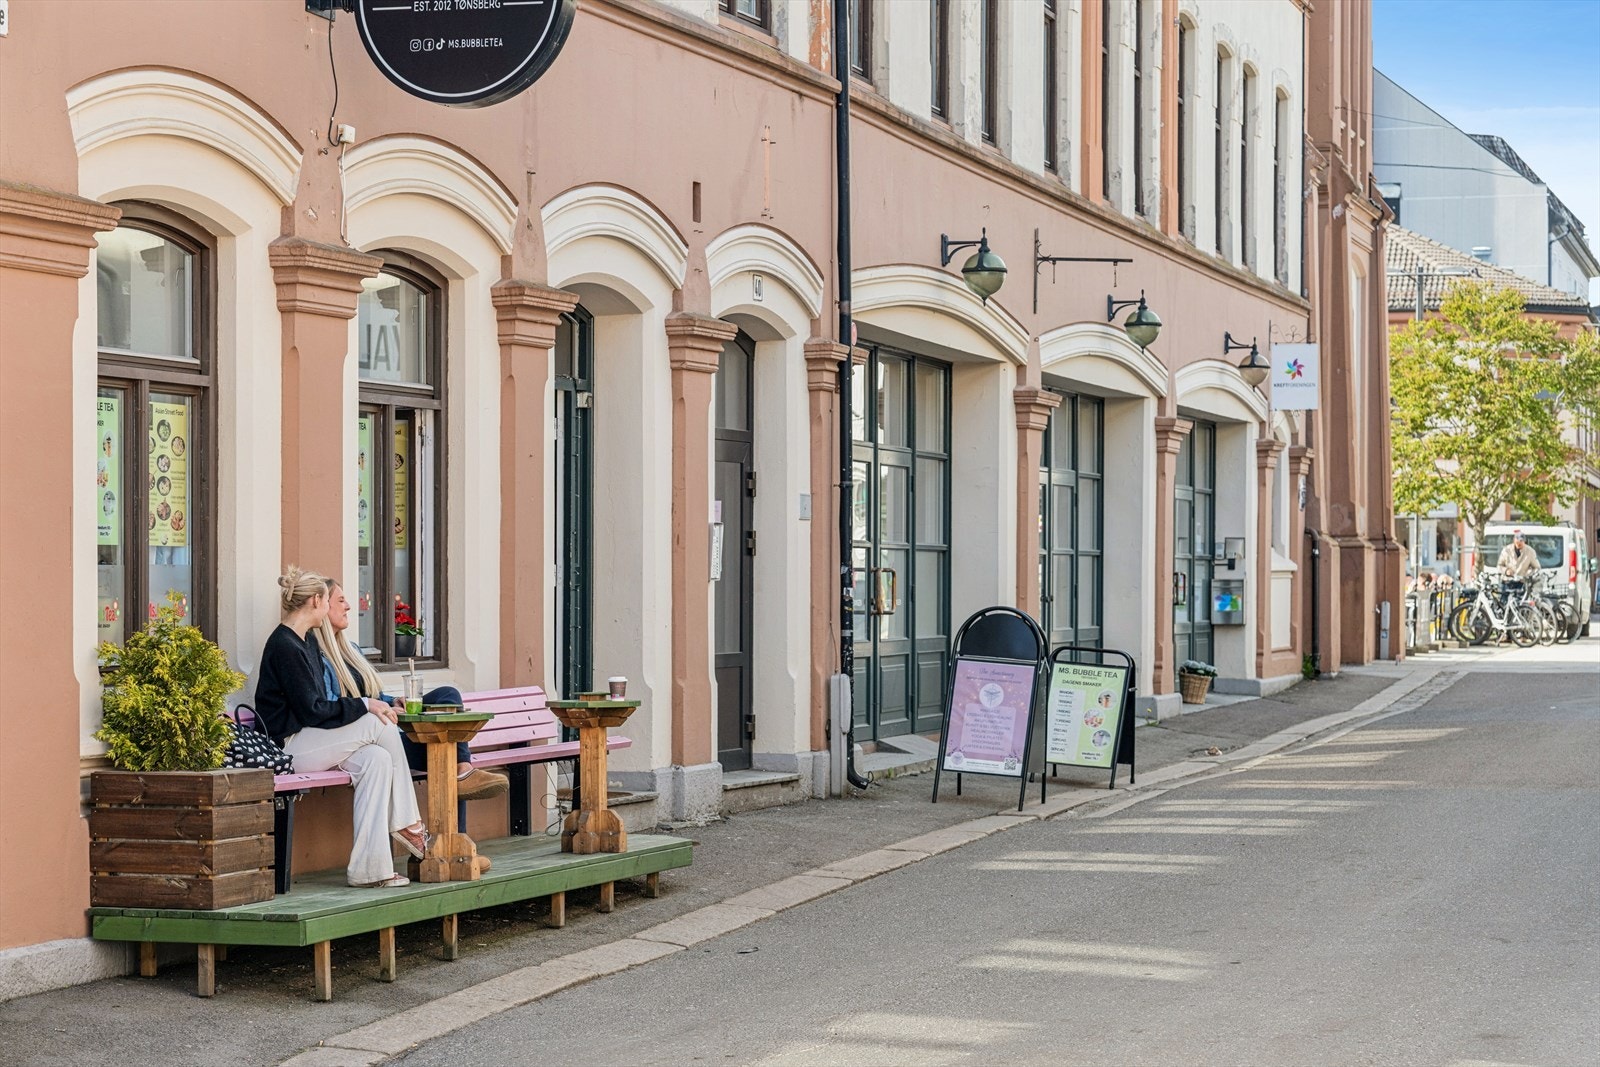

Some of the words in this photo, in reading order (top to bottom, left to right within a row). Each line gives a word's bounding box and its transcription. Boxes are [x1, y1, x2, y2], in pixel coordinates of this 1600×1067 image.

[414, 1, 431, 12] EST.
[433, 0, 452, 11] 2012
[454, 0, 501, 10] TØNSBERG
[447, 38, 504, 48] MS.BUBBLETEA
[755, 278, 762, 297] 40
[104, 402, 114, 412] TEA
[1072, 668, 1102, 677] BUBBLE
[1104, 671, 1118, 679] TEA
